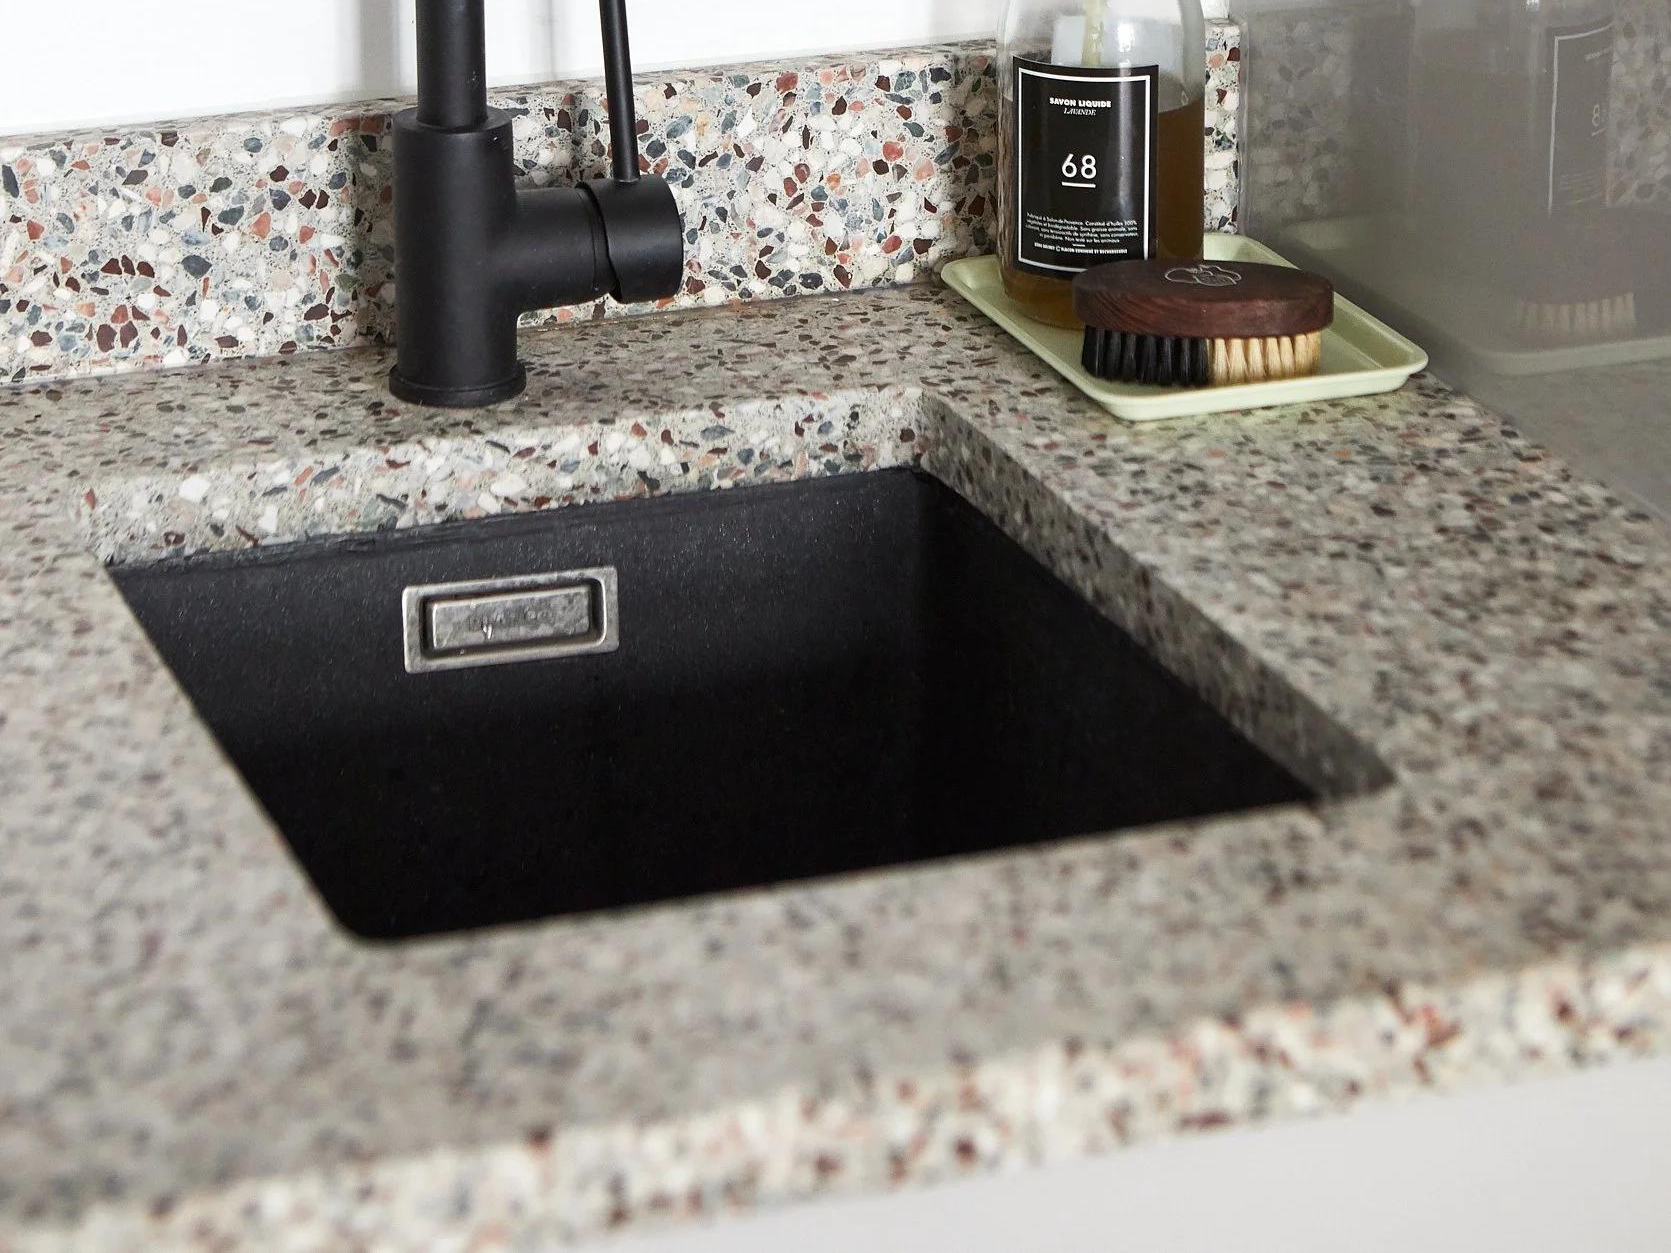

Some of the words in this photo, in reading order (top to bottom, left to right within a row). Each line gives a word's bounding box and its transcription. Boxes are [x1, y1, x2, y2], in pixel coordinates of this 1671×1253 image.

[1049, 97, 1077, 107] SAVON
[1078, 99, 1112, 108] LIQUIDE
[1063, 107, 1097, 116] LAVANDE
[1061, 153, 1097, 179] 68
